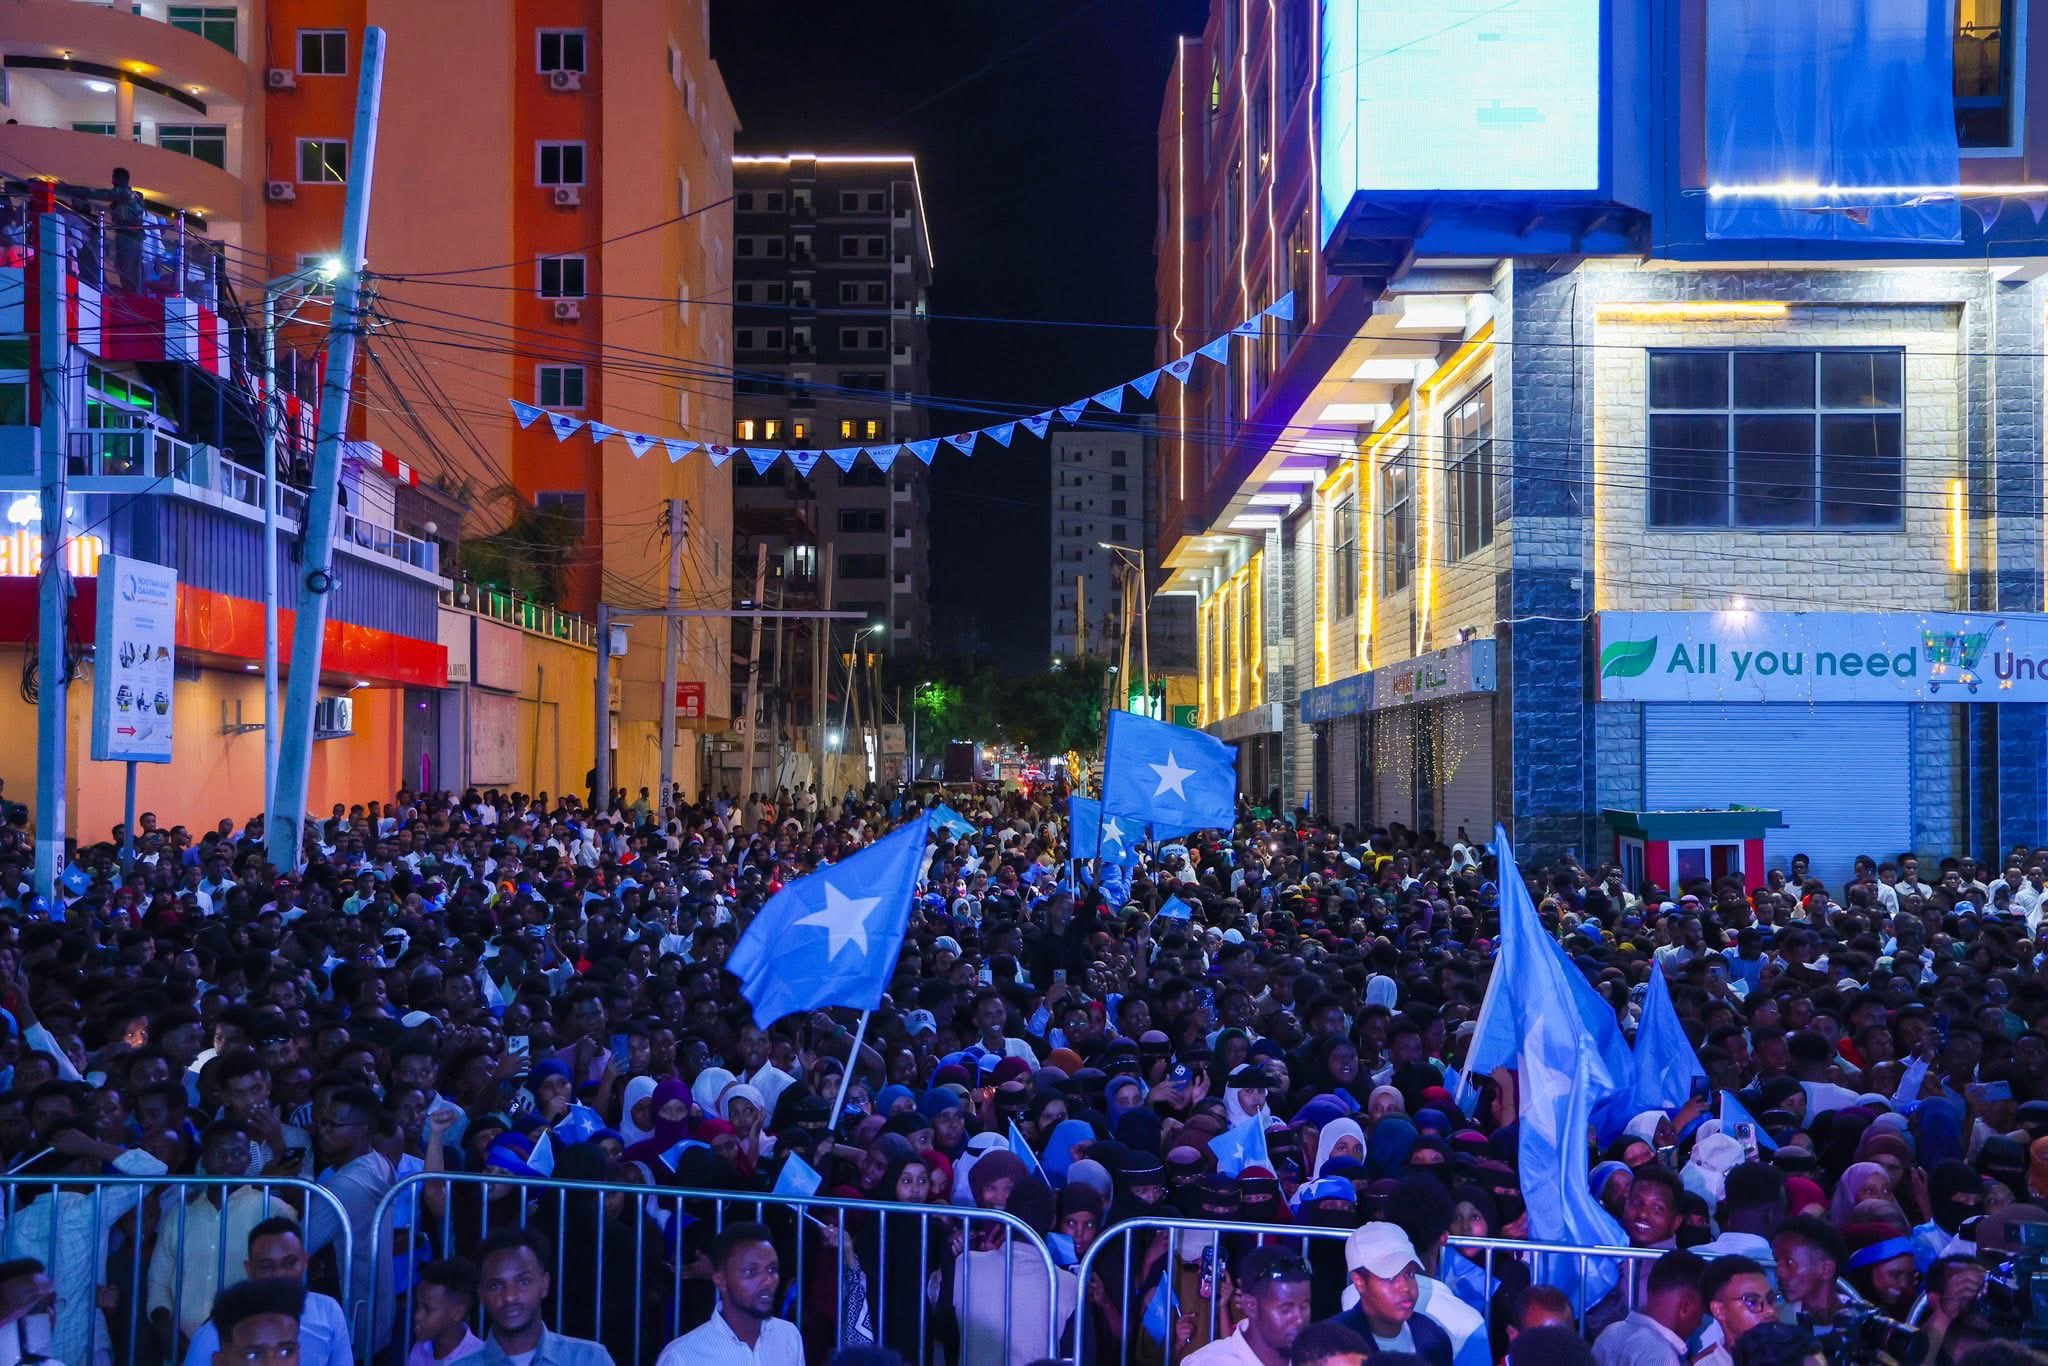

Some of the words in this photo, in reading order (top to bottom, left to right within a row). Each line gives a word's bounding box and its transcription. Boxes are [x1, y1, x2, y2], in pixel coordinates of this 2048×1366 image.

[1667, 643, 1717, 675] All
[1731, 650, 1803, 682] you
[1816, 645, 1918, 678] need
